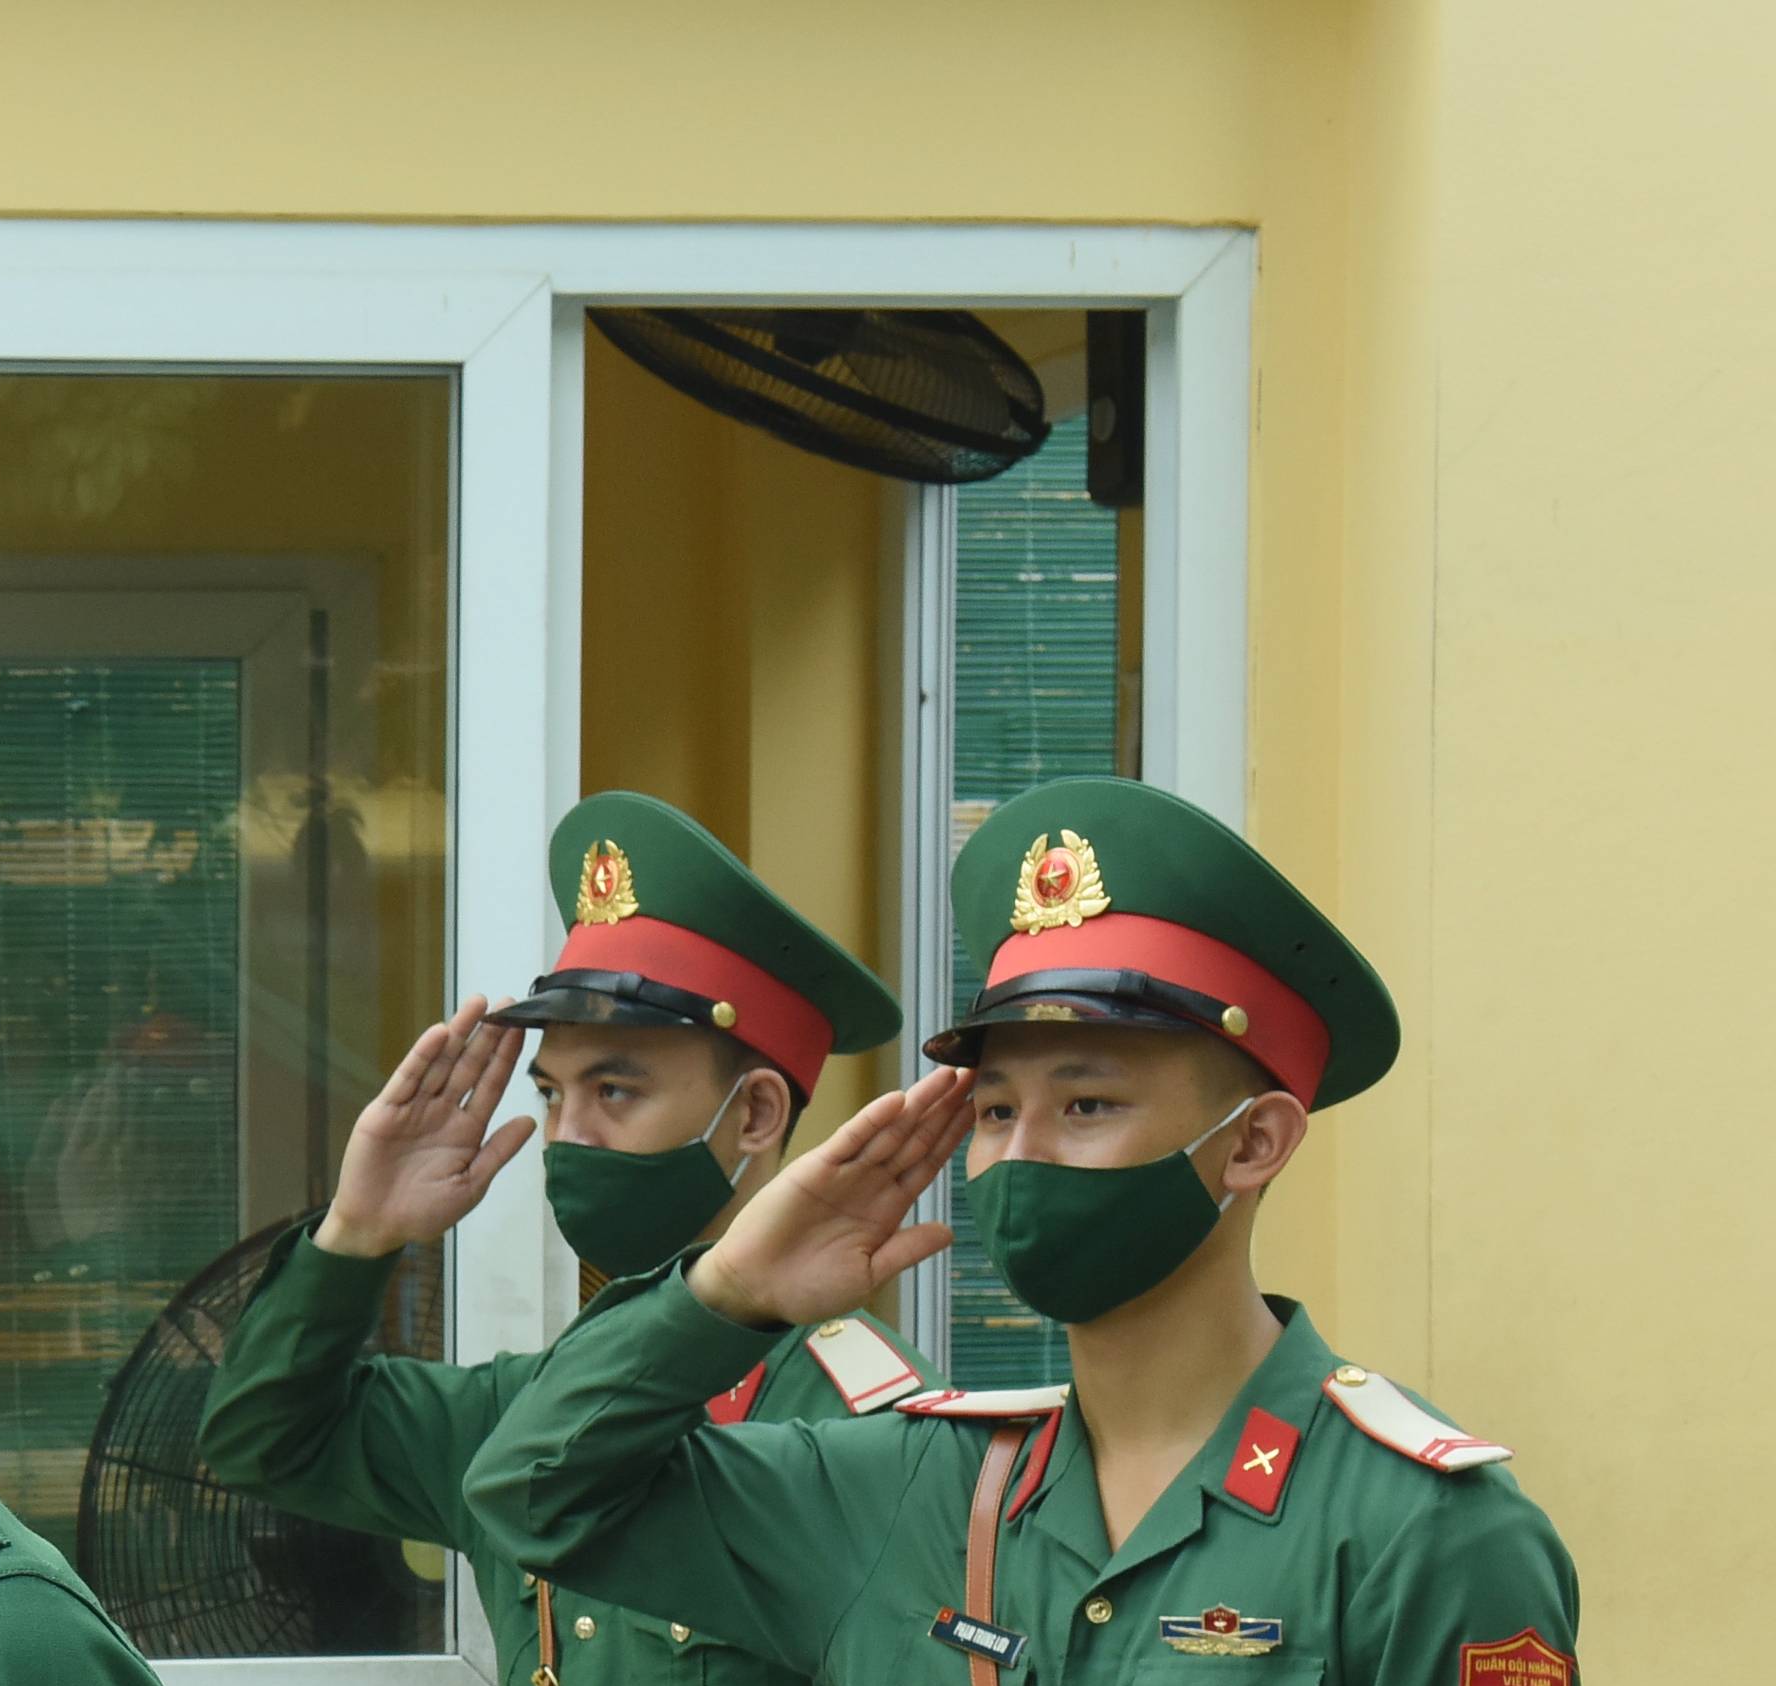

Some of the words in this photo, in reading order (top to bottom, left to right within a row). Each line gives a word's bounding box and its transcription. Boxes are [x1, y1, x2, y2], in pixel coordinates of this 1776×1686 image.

[1476, 1656, 1506, 1673] QUÂN
[1508, 1657, 1526, 1673] ĐỘI
[1528, 1660, 1550, 1675] NHÂN
